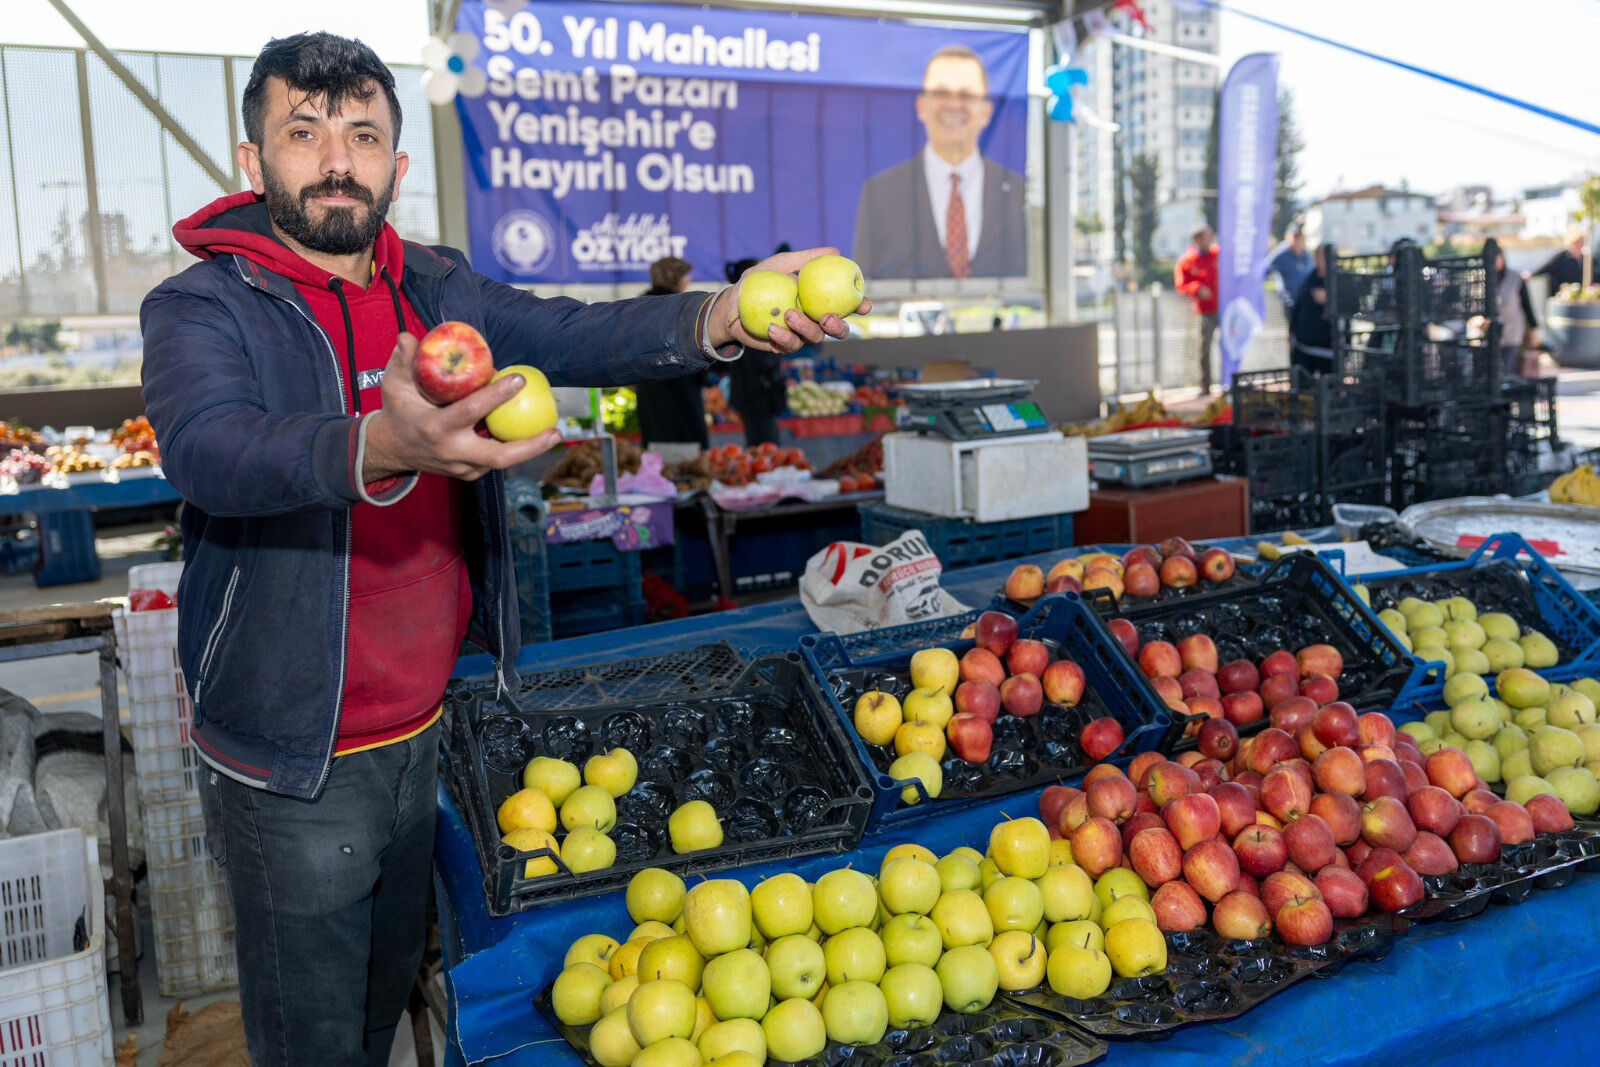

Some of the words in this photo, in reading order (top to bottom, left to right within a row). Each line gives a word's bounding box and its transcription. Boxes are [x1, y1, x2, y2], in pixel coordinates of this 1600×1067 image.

[483, 8, 554, 56] 50.
[562, 16, 618, 60] Yıl
[628, 21, 821, 72] Mahallesi
[487, 55, 599, 101] Semt
[610, 64, 738, 109] Pazarı
[490, 147, 627, 199] Hayırlı
[636, 152, 754, 193] Olsun
